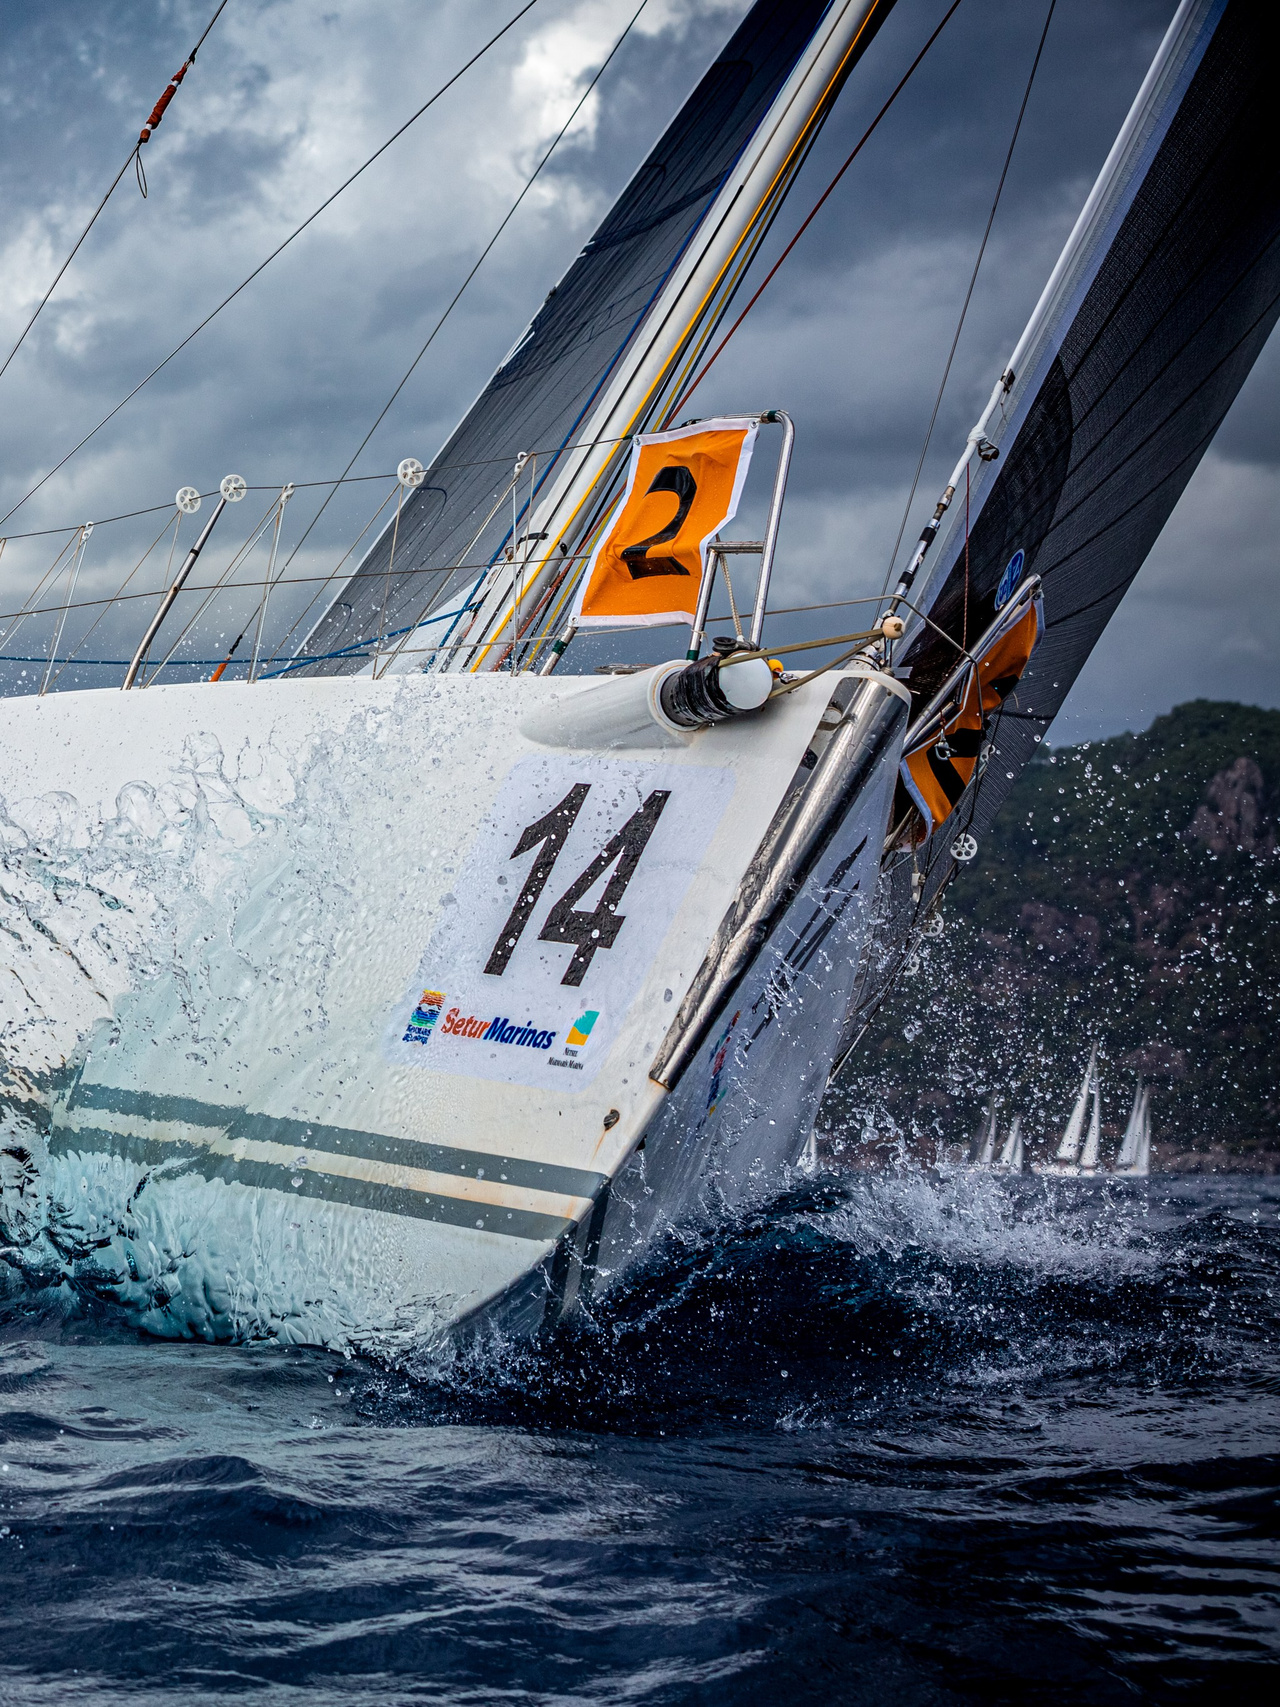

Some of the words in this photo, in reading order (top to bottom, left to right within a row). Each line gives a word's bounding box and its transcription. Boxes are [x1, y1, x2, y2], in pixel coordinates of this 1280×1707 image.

[620, 465, 698, 580] 2
[483, 783, 672, 987] 14
[441, 1007, 556, 1049] SeturMarinas
